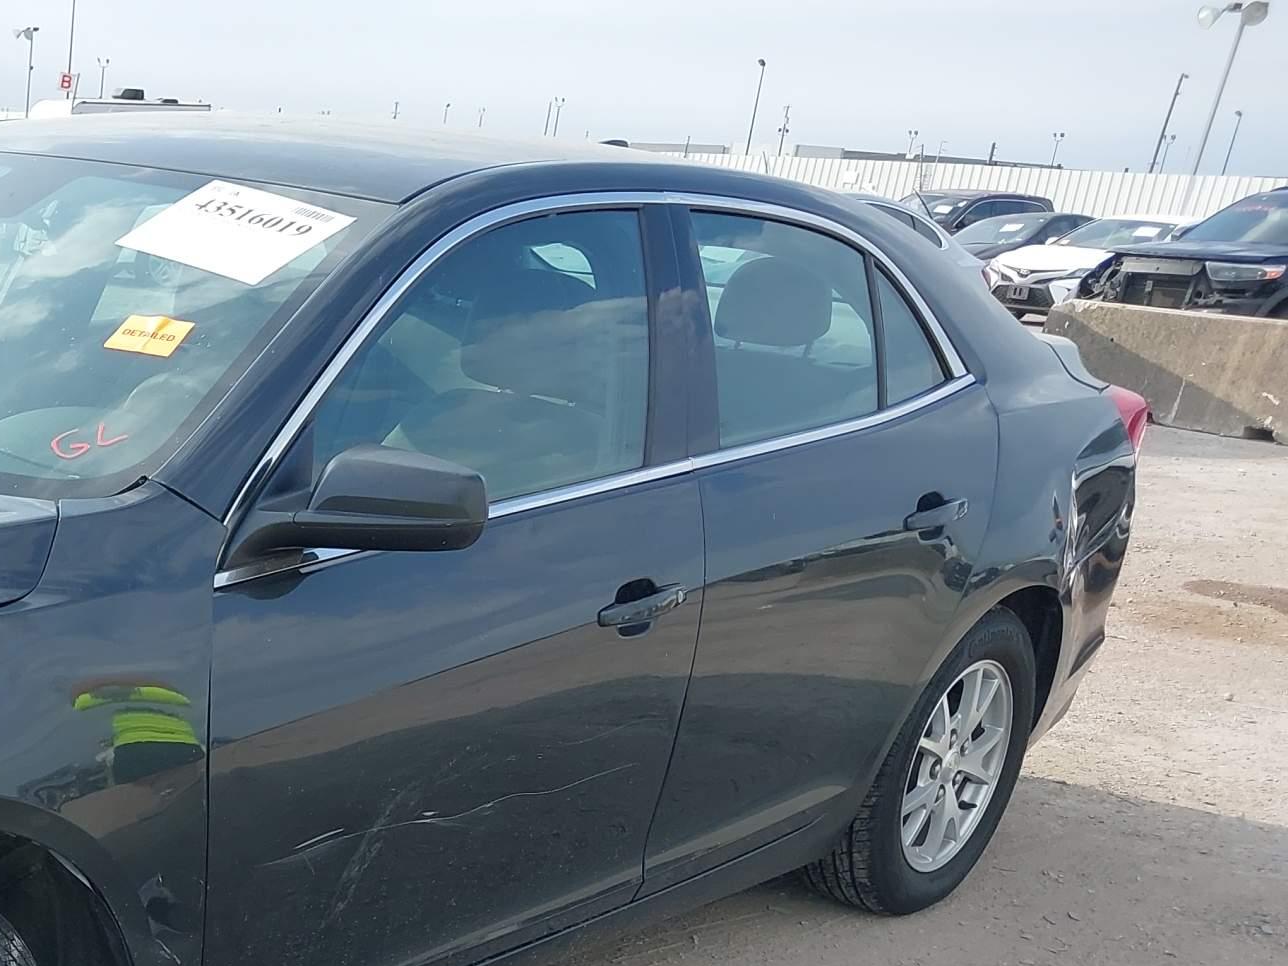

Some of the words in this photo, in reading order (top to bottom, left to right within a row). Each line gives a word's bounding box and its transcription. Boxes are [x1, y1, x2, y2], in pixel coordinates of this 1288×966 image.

[61, 75, 72, 89] B
[195, 199, 313, 236] 43516019
[122, 328, 176, 342] DETAILED
